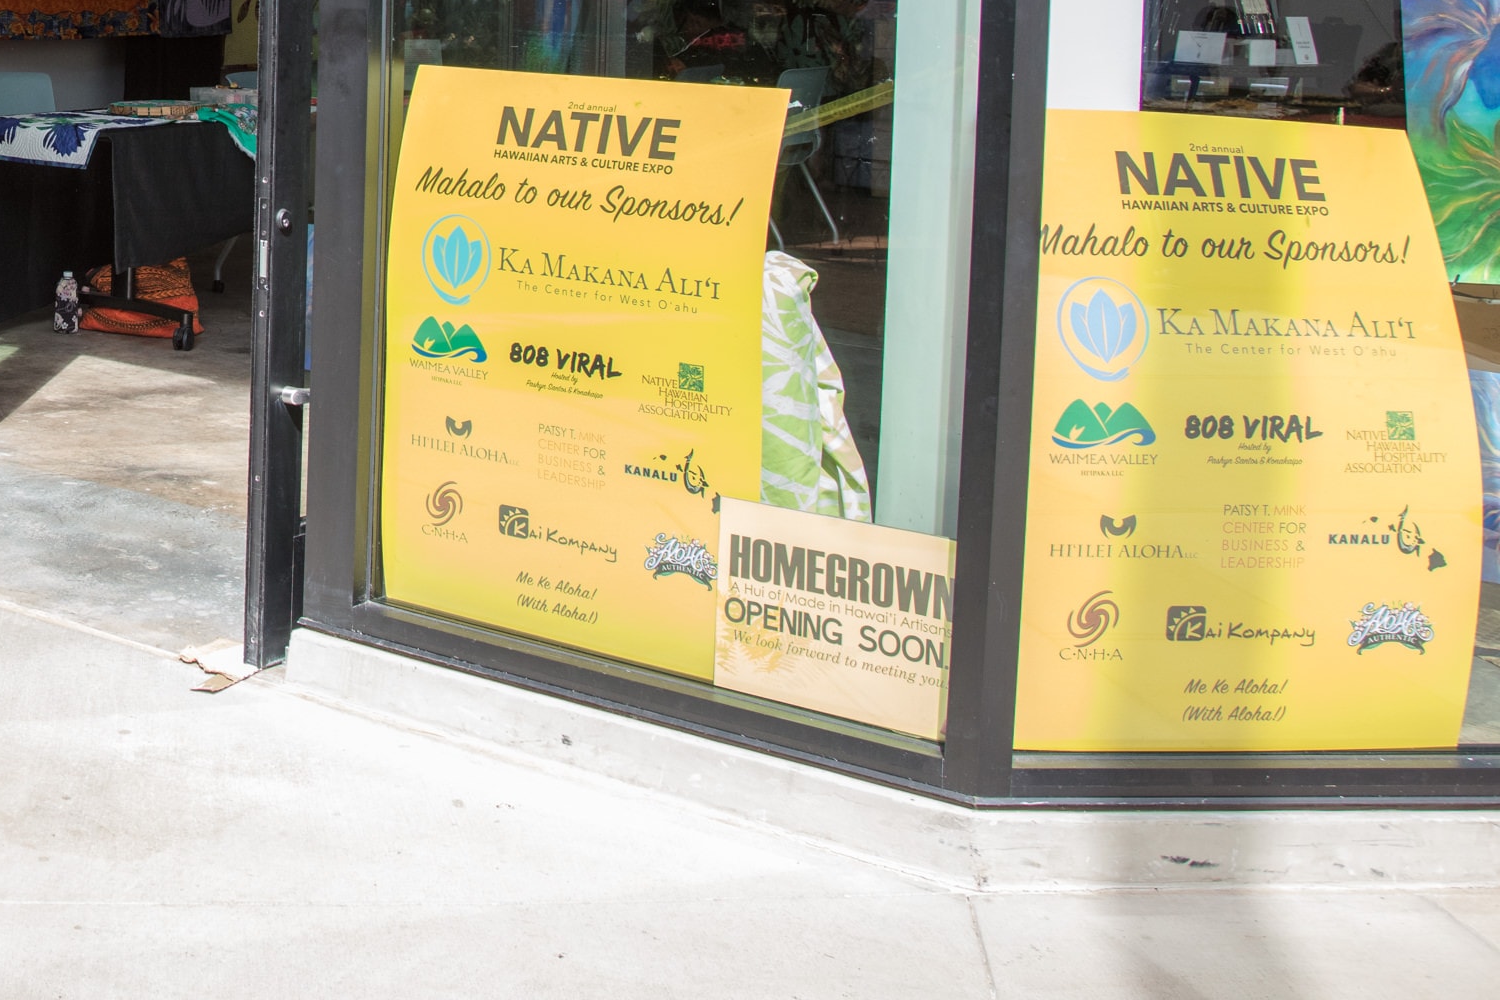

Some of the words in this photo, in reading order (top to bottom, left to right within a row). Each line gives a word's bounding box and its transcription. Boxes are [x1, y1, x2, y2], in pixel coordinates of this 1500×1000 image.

[568, 101, 587, 111] 2nd
[589, 103, 617, 113] annual
[496, 106, 681, 161] NATIVE
[1189, 143, 1208, 153] 2nd
[1211, 144, 1244, 155] annual
[493, 149, 548, 165] HAWAIIAN
[550, 154, 578, 167] ARTS
[580, 157, 588, 168] &
[591, 158, 639, 172] CULTURE
[642, 163, 673, 175] EXPO
[1115, 150, 1326, 202] NATIVE
[415, 166, 506, 201] Mahalo
[514, 178, 538, 205] to
[547, 188, 592, 211] our
[600, 185, 744, 227] Sponsors!
[1121, 200, 1189, 212] HAWAIIAN
[1191, 201, 1224, 213] ARTS
[1226, 202, 1236, 214] &
[1239, 202, 1292, 215] CULTURE
[1295, 204, 1329, 217] EXPO
[1040, 224, 1149, 258] Mahalo
[1161, 229, 1188, 258] to
[1201, 237, 1255, 260] our
[1264, 230, 1410, 270] Sponsors!
[517, 280, 537, 292] The
[545, 283, 589, 298] Center
[594, 289, 613, 302] for
[619, 294, 652, 308] West
[1185, 343, 1211, 355] The
[1220, 343, 1272, 356] Center
[1280, 344, 1301, 356] for
[1309, 345, 1347, 357] West
[409, 358, 450, 375] WAIMEA
[452, 365, 488, 380] VALLEY
[510, 342, 549, 367] 808
[556, 348, 623, 380] VIRAL
[642, 375, 678, 389] NATIVE
[659, 387, 708, 403] HAWAIIAN
[638, 403, 708, 422] ASSOCIATION
[665, 397, 733, 416] HOSPITALITY
[538, 423, 568, 438] PATSY
[1185, 414, 1234, 439] 808
[1242, 414, 1324, 443] VIRAL
[460, 444, 509, 464] ALOHA
[583, 447, 606, 460] FOR
[1049, 453, 1108, 465] WAIMEA
[1110, 454, 1158, 465] VALLEY
[624, 464, 678, 483] KANALU
[1223, 504, 1260, 516] PATSY
[1263, 504, 1270, 517] T.
[1273, 504, 1307, 516] MINK
[1222, 522, 1274, 534] CENTER
[1279, 522, 1307, 534] FOR
[1222, 539, 1289, 551] BUSINESS
[1295, 540, 1306, 552] &
[1328, 534, 1390, 545] KANALU
[1118, 544, 1184, 558] ALOHA
[1221, 556, 1305, 569] LEADERSHIP
[516, 571, 534, 586] Me
[537, 575, 551, 590] Ke
[554, 580, 598, 600] Aloha!
[729, 534, 955, 622] HOMEGROWN
[517, 593, 548, 613] (With
[552, 603, 599, 625] Aloha!)
[730, 582, 741, 593] A
[744, 583, 764, 598] Hui
[768, 587, 782, 601] of
[785, 592, 825, 611] Made
[829, 600, 840, 613] in
[900, 617, 952, 638] Artisans
[724, 597, 843, 646] OPENING
[858, 625, 950, 670] SOON.
[1368, 633, 1418, 644] AUTHENTIC
[733, 629, 752, 644] We
[755, 635, 783, 651] look
[786, 642, 841, 665] forward
[845, 656, 857, 668] to
[862, 661, 916, 684] meeting
[1184, 679, 1207, 695] Me
[1211, 679, 1229, 694] Ke
[1234, 678, 1289, 695] Aloha!
[1182, 706, 1223, 722] (With
[1227, 706, 1287, 722] Aloha!)
